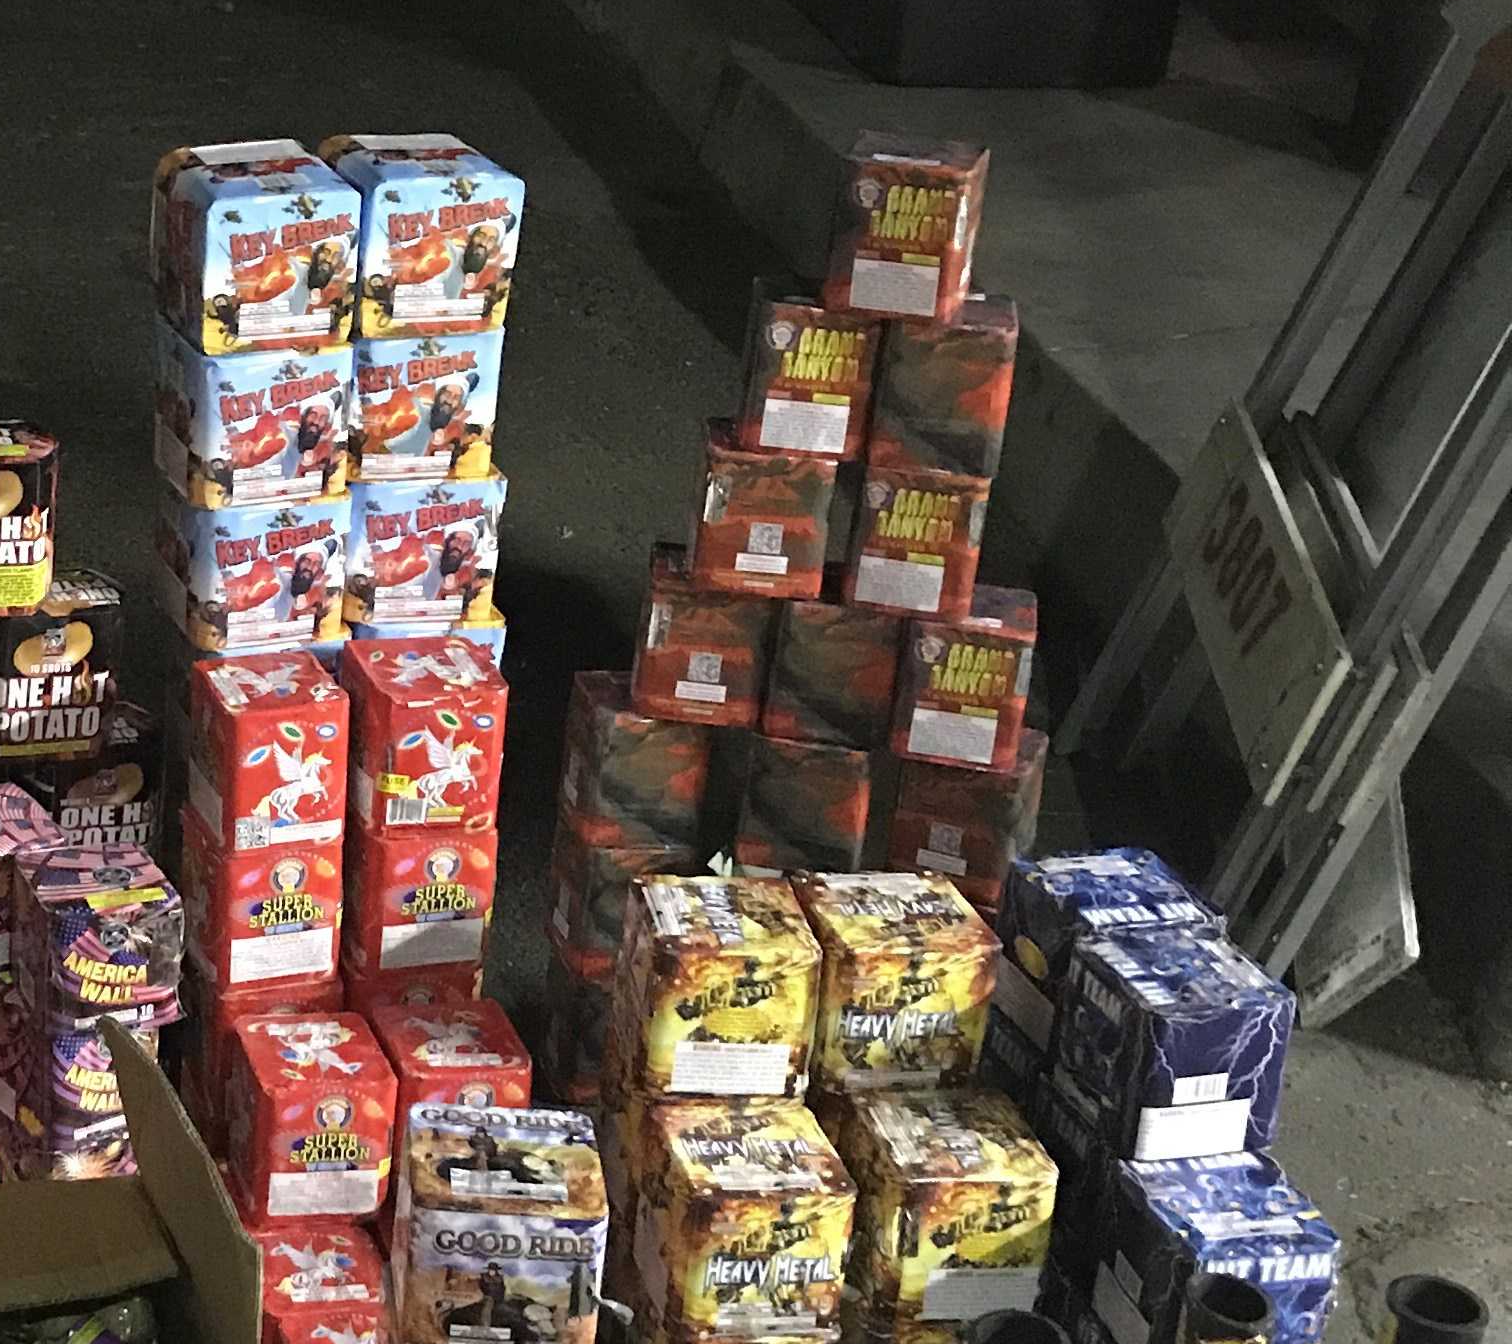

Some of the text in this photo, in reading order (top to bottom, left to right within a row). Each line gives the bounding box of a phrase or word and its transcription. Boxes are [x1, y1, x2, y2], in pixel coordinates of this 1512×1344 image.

[387, 197, 512, 244] KEY BREAK
[230, 213, 356, 265] KEY BREAK
[358, 350, 478, 395] KEY BREAK
[219, 368, 341, 425] KEY BREAK
[365, 498, 486, 544] KEY BREAK
[215, 518, 336, 569] KEY BREAK
[61, 804, 116, 830] ONE
[65, 823, 152, 848] POTAT
[262, 893, 314, 914] SUPER
[401, 896, 477, 916] STALLION
[415, 884, 466, 901] SUPER
[249, 908, 325, 930] STALLION
[63, 950, 148, 986] AMERICA
[79, 979, 136, 1004] WALL
[835, 1009, 958, 1040] HEAVY METAL
[65, 1063, 118, 1093] AMERI
[421, 1107, 506, 1127] GOOD
[290, 1145, 370, 1164] STALLION
[303, 1132, 358, 1150] SUPER
[683, 1136, 814, 1157] HEAVY METAL
[435, 1229, 598, 1259] GOOD RIDE
[702, 1254, 838, 1288] HEAVY METAL
[1259, 1253, 1332, 1283] TEAM
